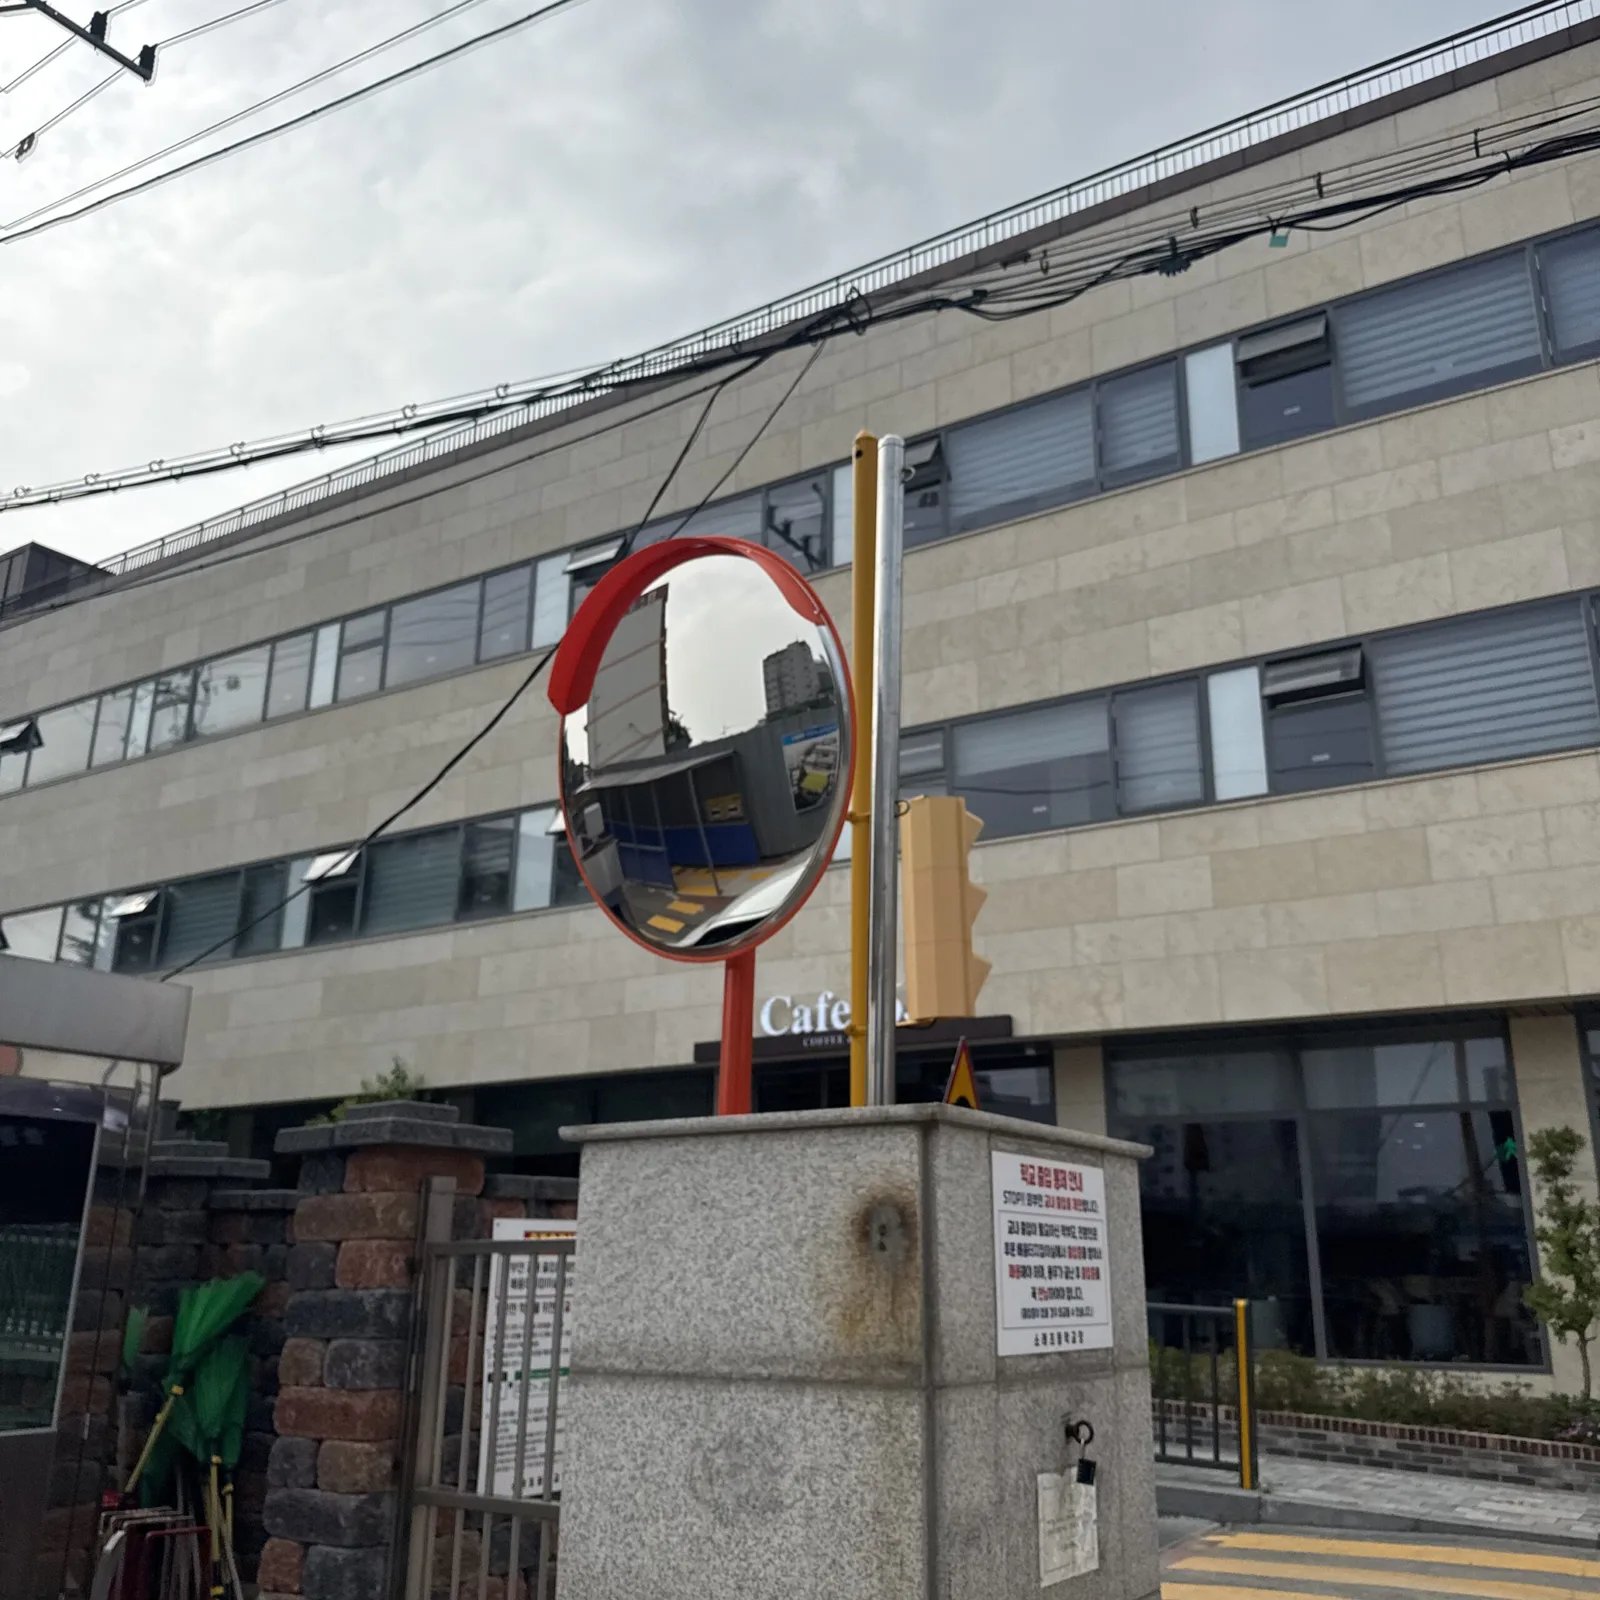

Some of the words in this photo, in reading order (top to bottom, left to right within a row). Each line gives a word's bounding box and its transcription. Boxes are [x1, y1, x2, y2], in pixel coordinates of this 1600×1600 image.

[760, 990, 852, 1036] Cafe
[1020, 1163, 1036, 1187] 학교
[1038, 1166, 1052, 1189] 출입
[1069, 1170, 1083, 1192] 안내
